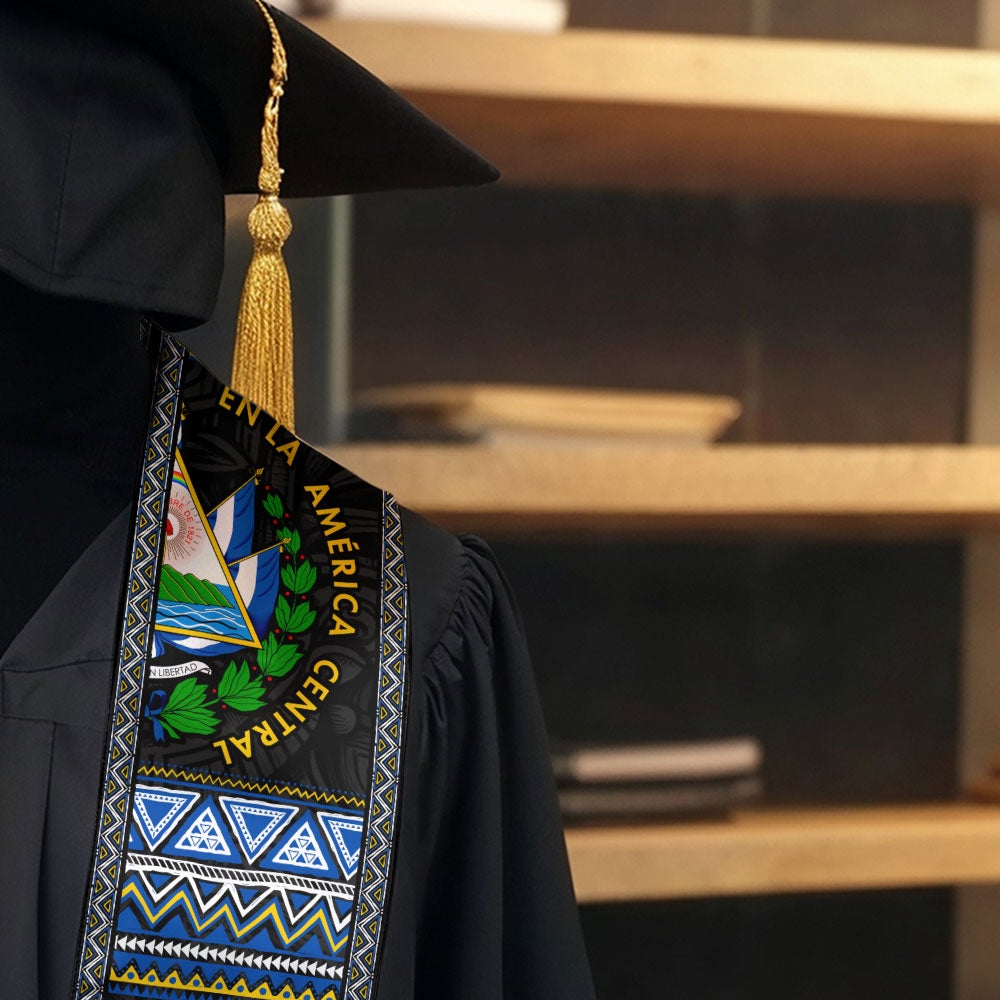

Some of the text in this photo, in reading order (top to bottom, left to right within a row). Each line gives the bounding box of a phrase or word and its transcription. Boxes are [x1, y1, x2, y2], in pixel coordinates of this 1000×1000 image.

[158, 662, 198, 677] LIBERTAD
[212, 386, 360, 765] EN LA AMÉRICA CENTRAL
